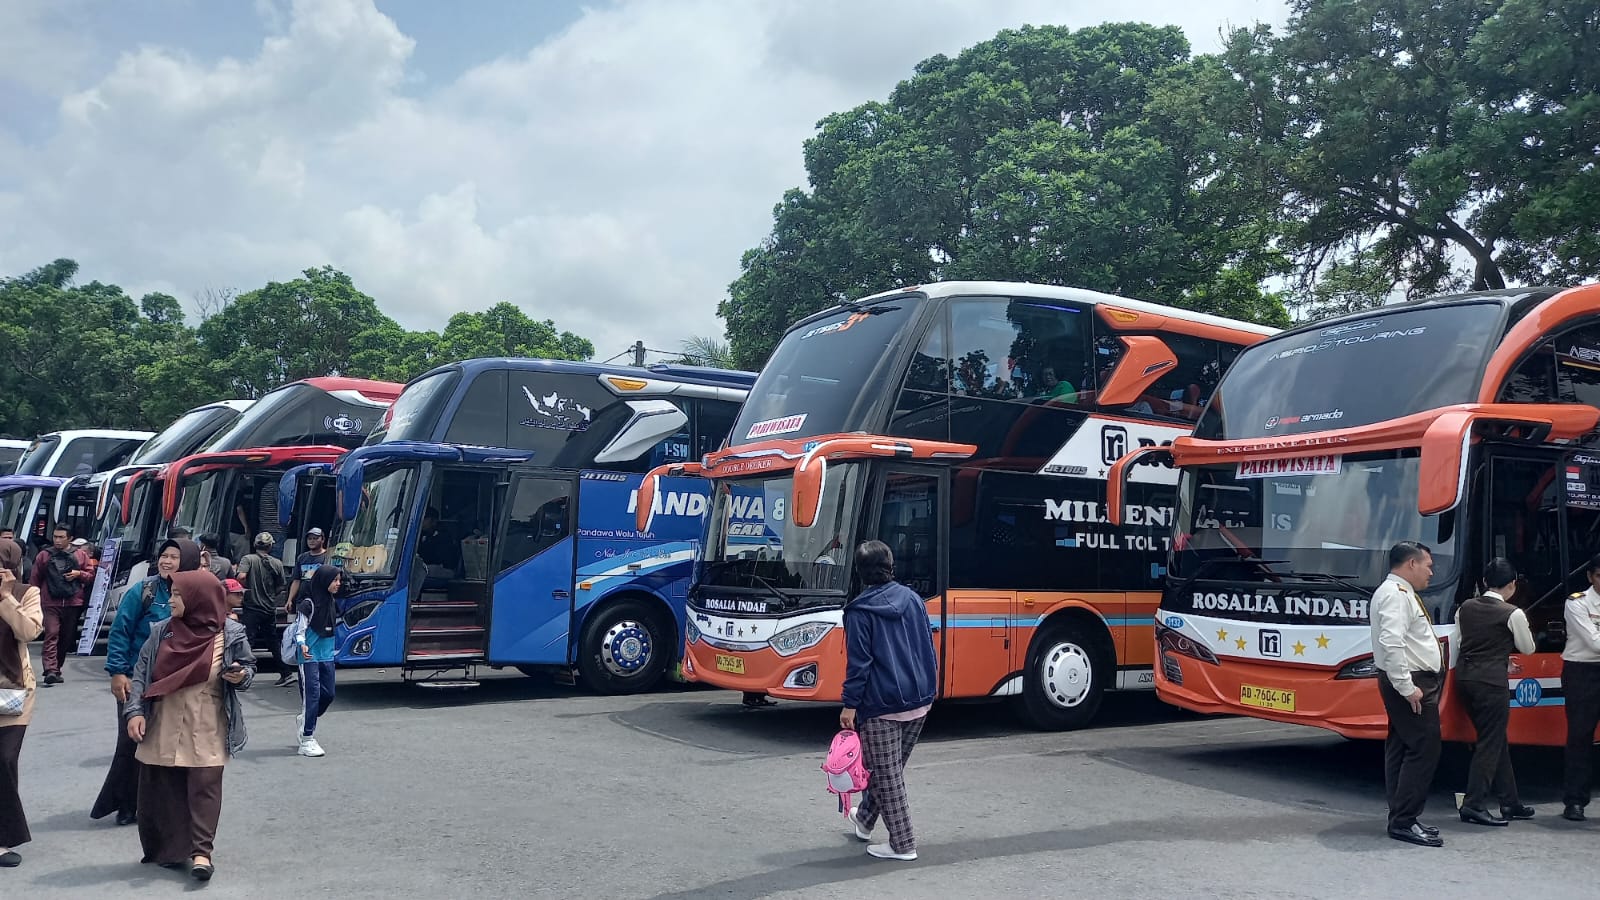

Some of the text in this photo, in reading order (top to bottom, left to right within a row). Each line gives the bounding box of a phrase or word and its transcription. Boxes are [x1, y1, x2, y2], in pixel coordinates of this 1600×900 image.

[1333, 326, 1427, 346] TOURING
[1301, 408, 1343, 422] armada
[750, 416, 801, 436] PARIWISATA
[1305, 436, 1348, 446] PLUS
[1044, 464, 1087, 475] JETBUS
[1240, 455, 1336, 475] PARIWISATA
[580, 472, 626, 482] JETBUS
[577, 528, 656, 539] Pandawa Wolu Tujuh
[1075, 532, 1119, 549] FULL
[1125, 535, 1157, 551] TOL
[705, 598, 767, 613] ROSALIA INDAH
[1192, 592, 1369, 619] ROSALIA INDAH
[1241, 687, 1252, 698] AD
[1519, 682, 1538, 703] 3132
